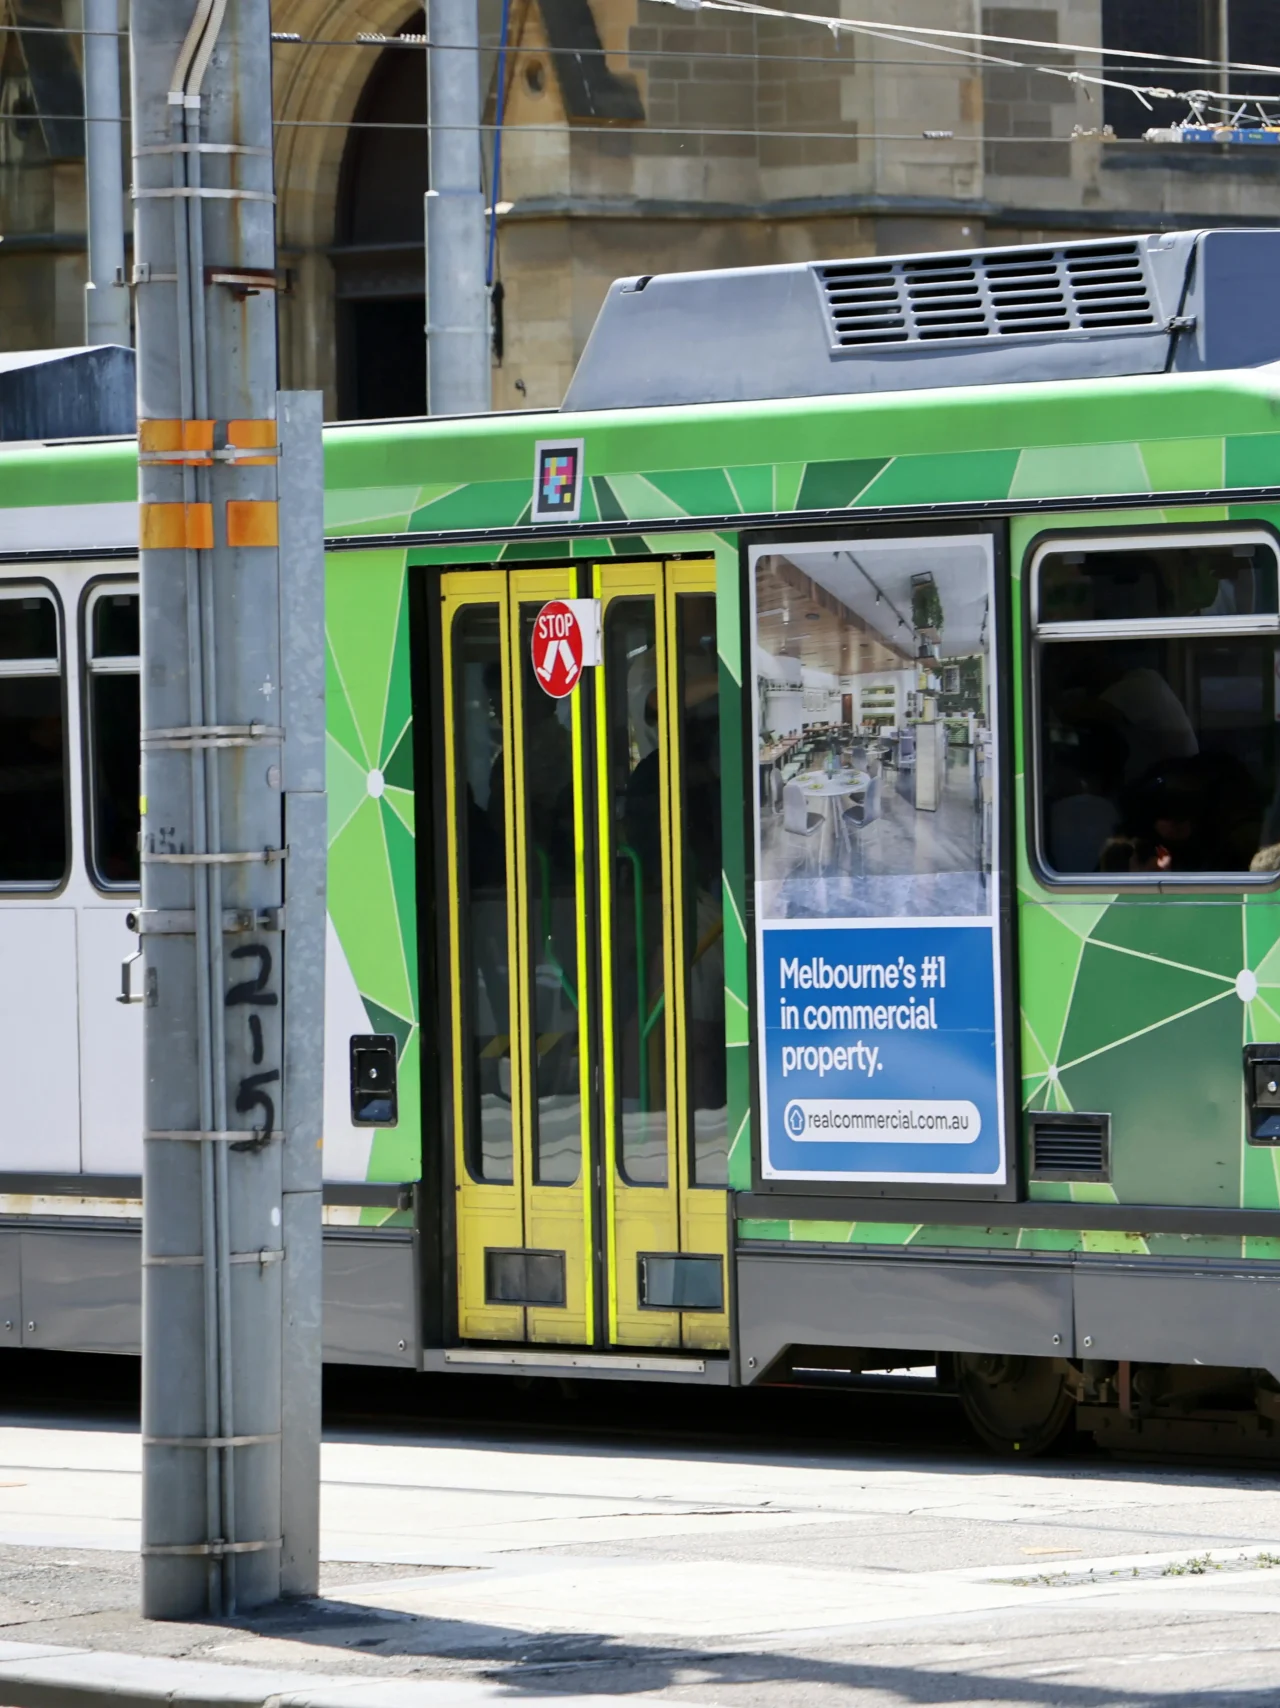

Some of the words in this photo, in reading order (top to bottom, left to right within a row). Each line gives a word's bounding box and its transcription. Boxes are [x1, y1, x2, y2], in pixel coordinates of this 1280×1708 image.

[538, 613, 574, 639] STOP
[779, 956, 916, 989] Melbourne's
[921, 955, 947, 989] #1
[780, 996, 799, 1030] in
[803, 996, 938, 1030] commercial
[781, 1040, 883, 1078] property.
[807, 1109, 969, 1131] realcommercial.com.au
